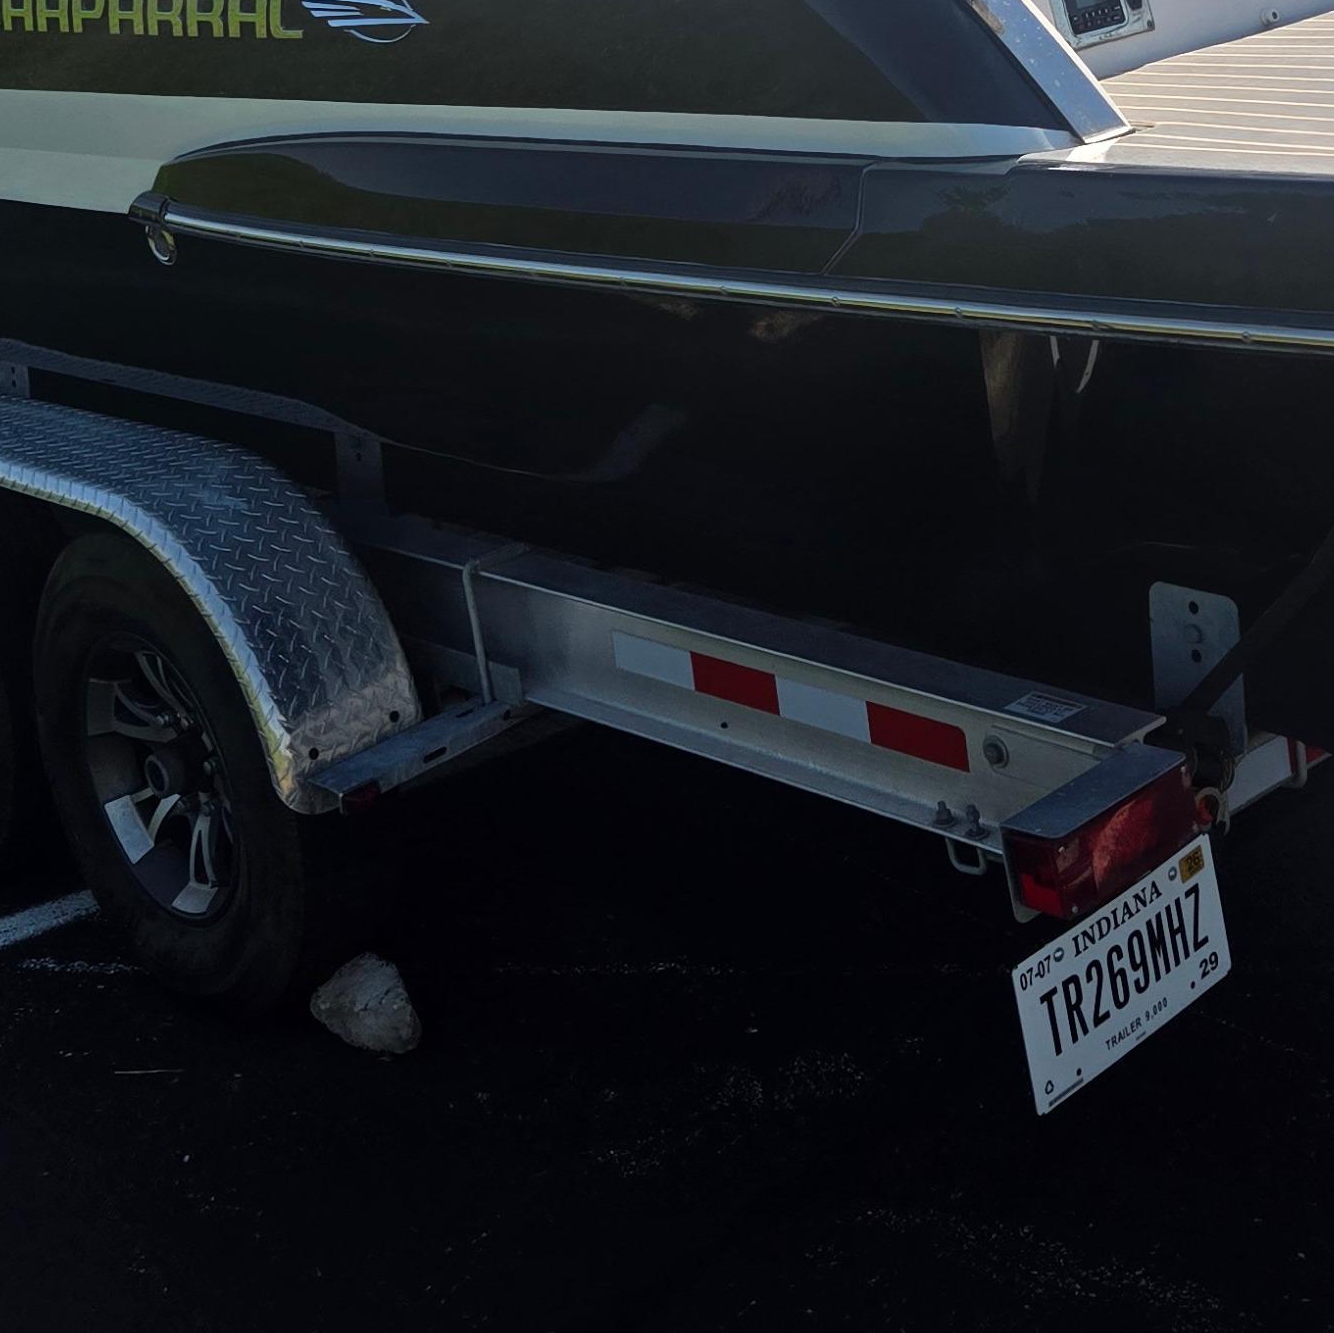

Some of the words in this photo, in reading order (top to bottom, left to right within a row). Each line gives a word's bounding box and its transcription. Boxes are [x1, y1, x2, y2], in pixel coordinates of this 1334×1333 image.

[1071, 880, 1162, 957] INDIANA
[1019, 955, 1052, 991] 07-07
[1040, 883, 1209, 1056] TR269MHZ
[1200, 951, 1219, 979] 29
[1105, 1016, 1142, 1050] TRAILER
